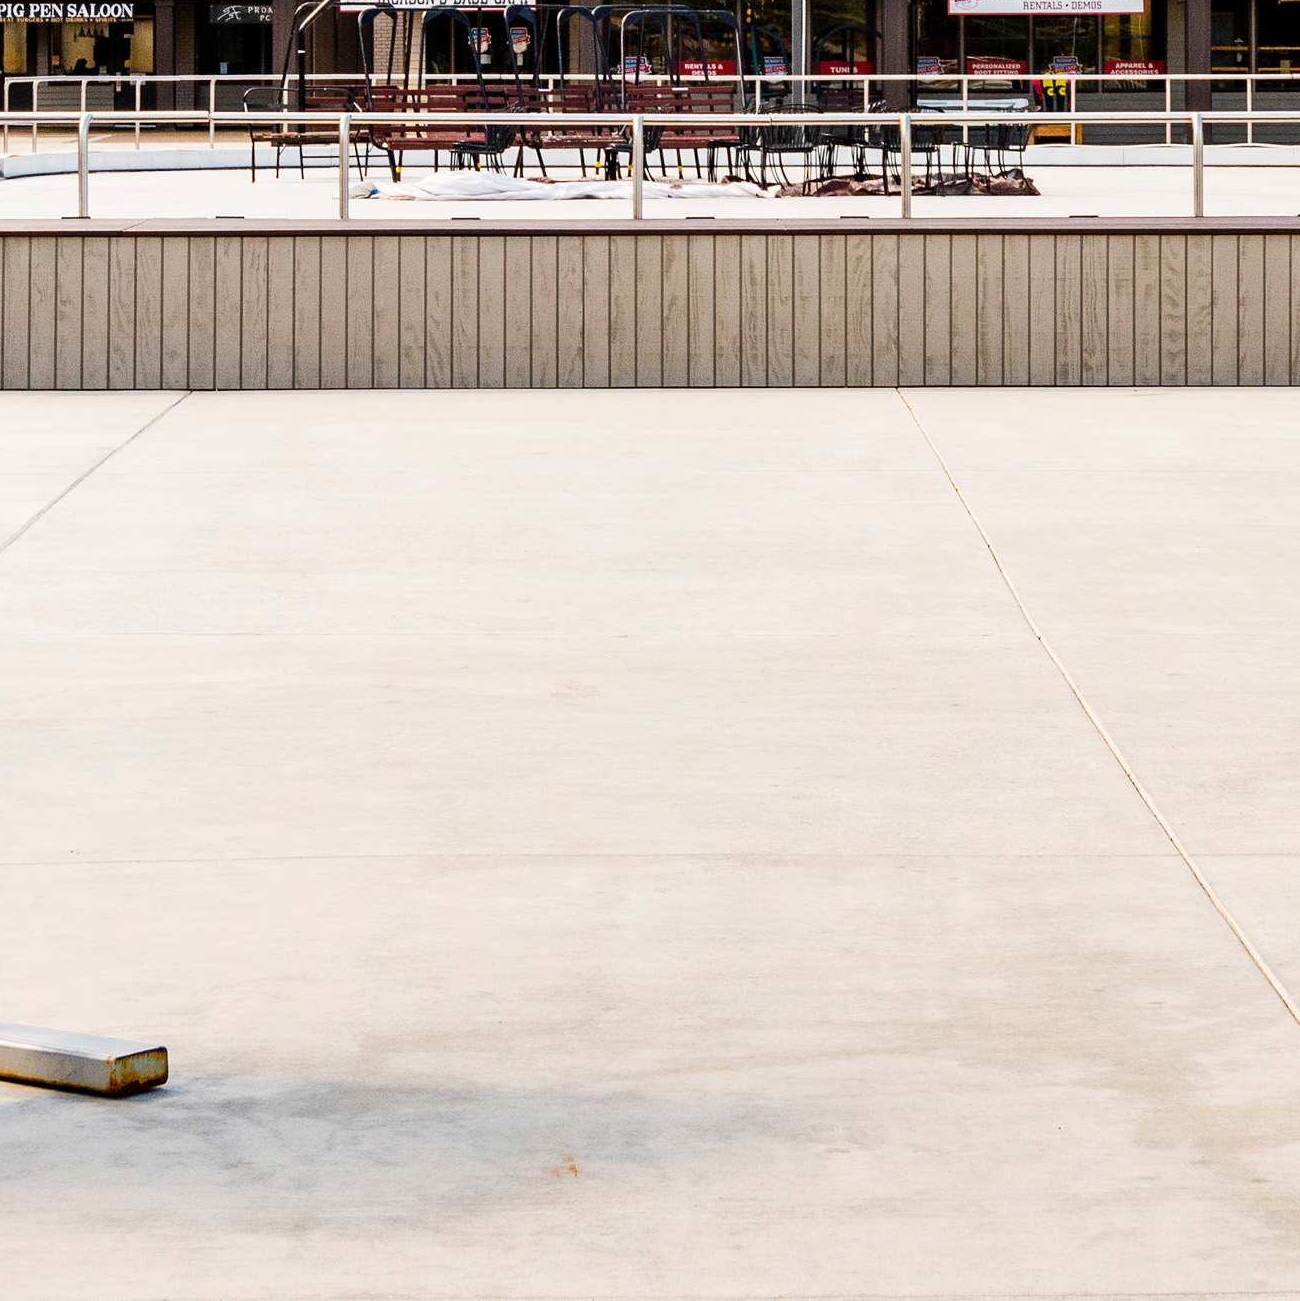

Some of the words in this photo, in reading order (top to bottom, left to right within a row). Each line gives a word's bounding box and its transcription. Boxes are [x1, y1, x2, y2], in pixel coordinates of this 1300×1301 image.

[28, 3, 64, 18] PEN
[67, 3, 134, 18] SALOON
[1023, 1, 1063, 10] RENTALS
[1071, 1, 1102, 10] DEMOS
